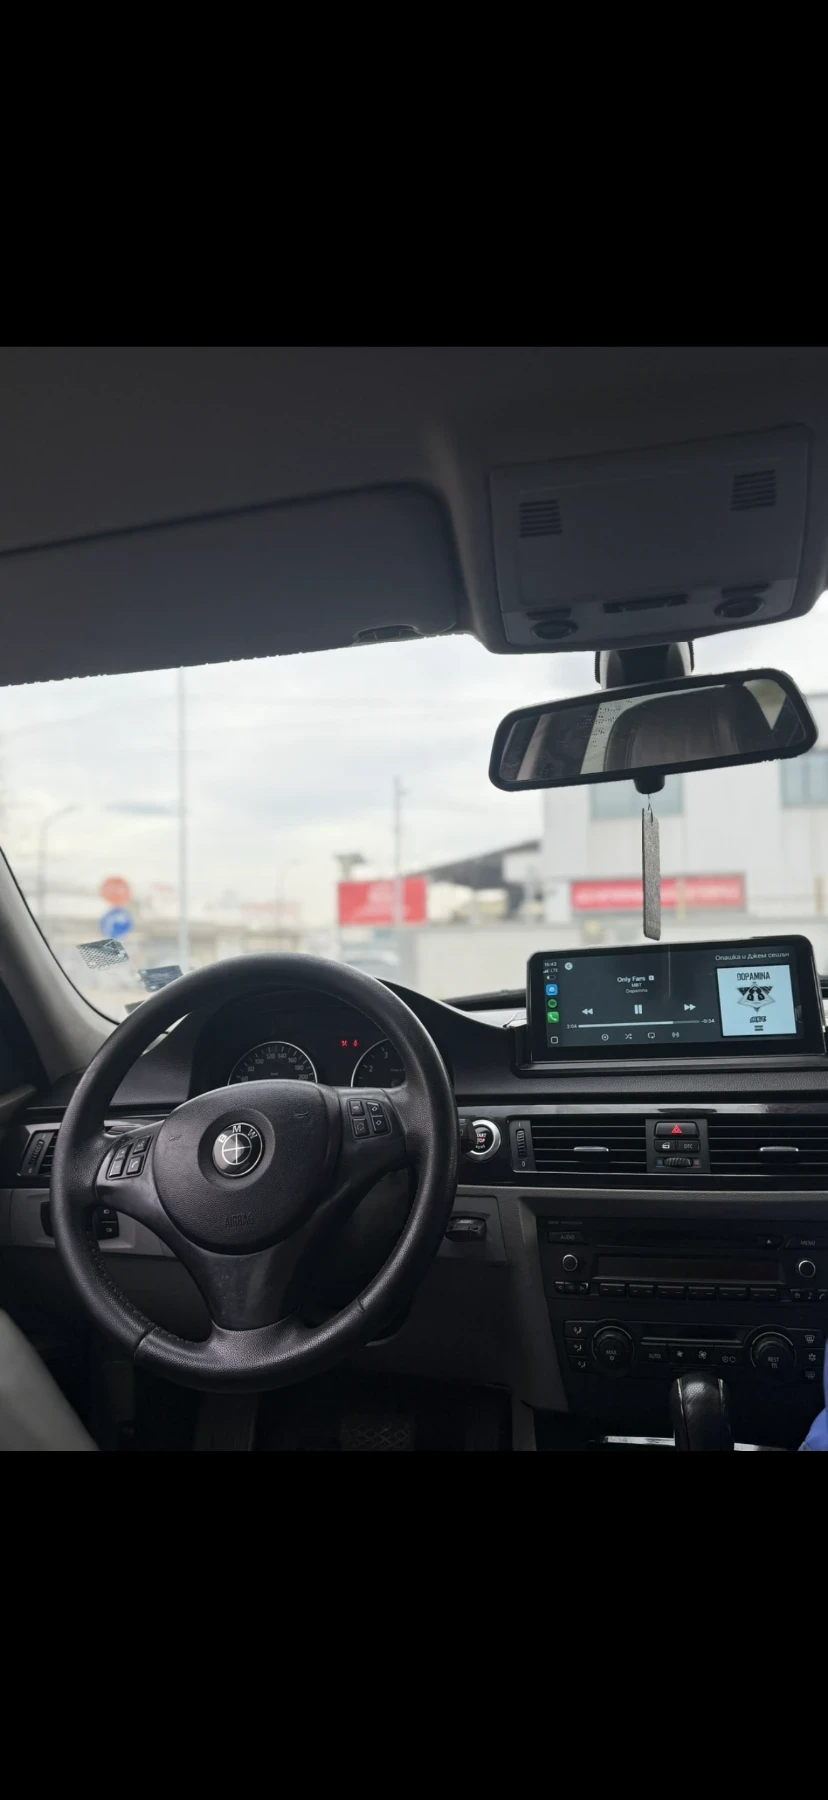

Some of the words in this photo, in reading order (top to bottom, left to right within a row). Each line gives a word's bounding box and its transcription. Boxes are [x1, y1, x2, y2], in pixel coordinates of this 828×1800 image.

[736, 971, 771, 981] DOPAMINA
[369, 1065, 374, 1073] 2
[217, 1124, 258, 1143] BMW
[224, 1212, 255, 1228] AIRBAG
